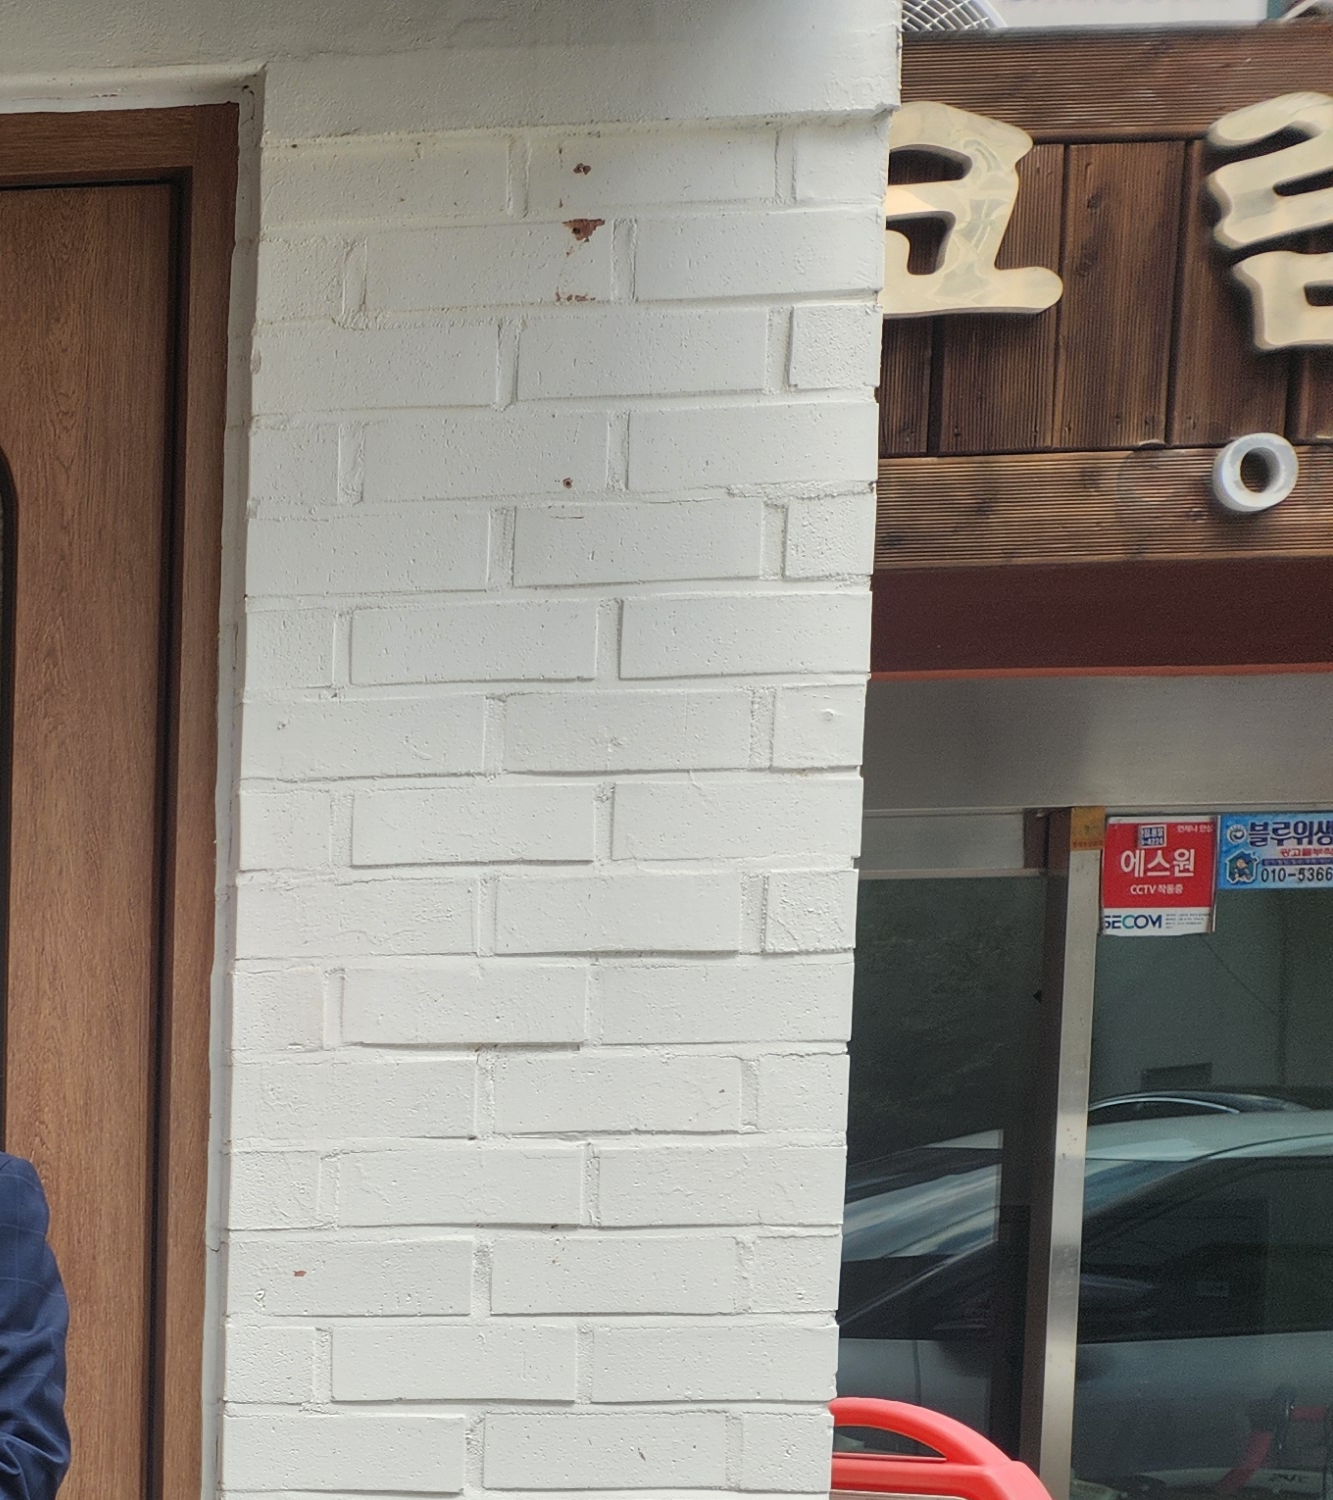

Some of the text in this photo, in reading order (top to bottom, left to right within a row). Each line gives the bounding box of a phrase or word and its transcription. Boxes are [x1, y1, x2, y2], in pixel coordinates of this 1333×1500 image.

[1120, 848, 1196, 878] 에스원
[1130, 883, 1183, 895] CCTV 작동중
[1104, 914, 1163, 929] SECOM
